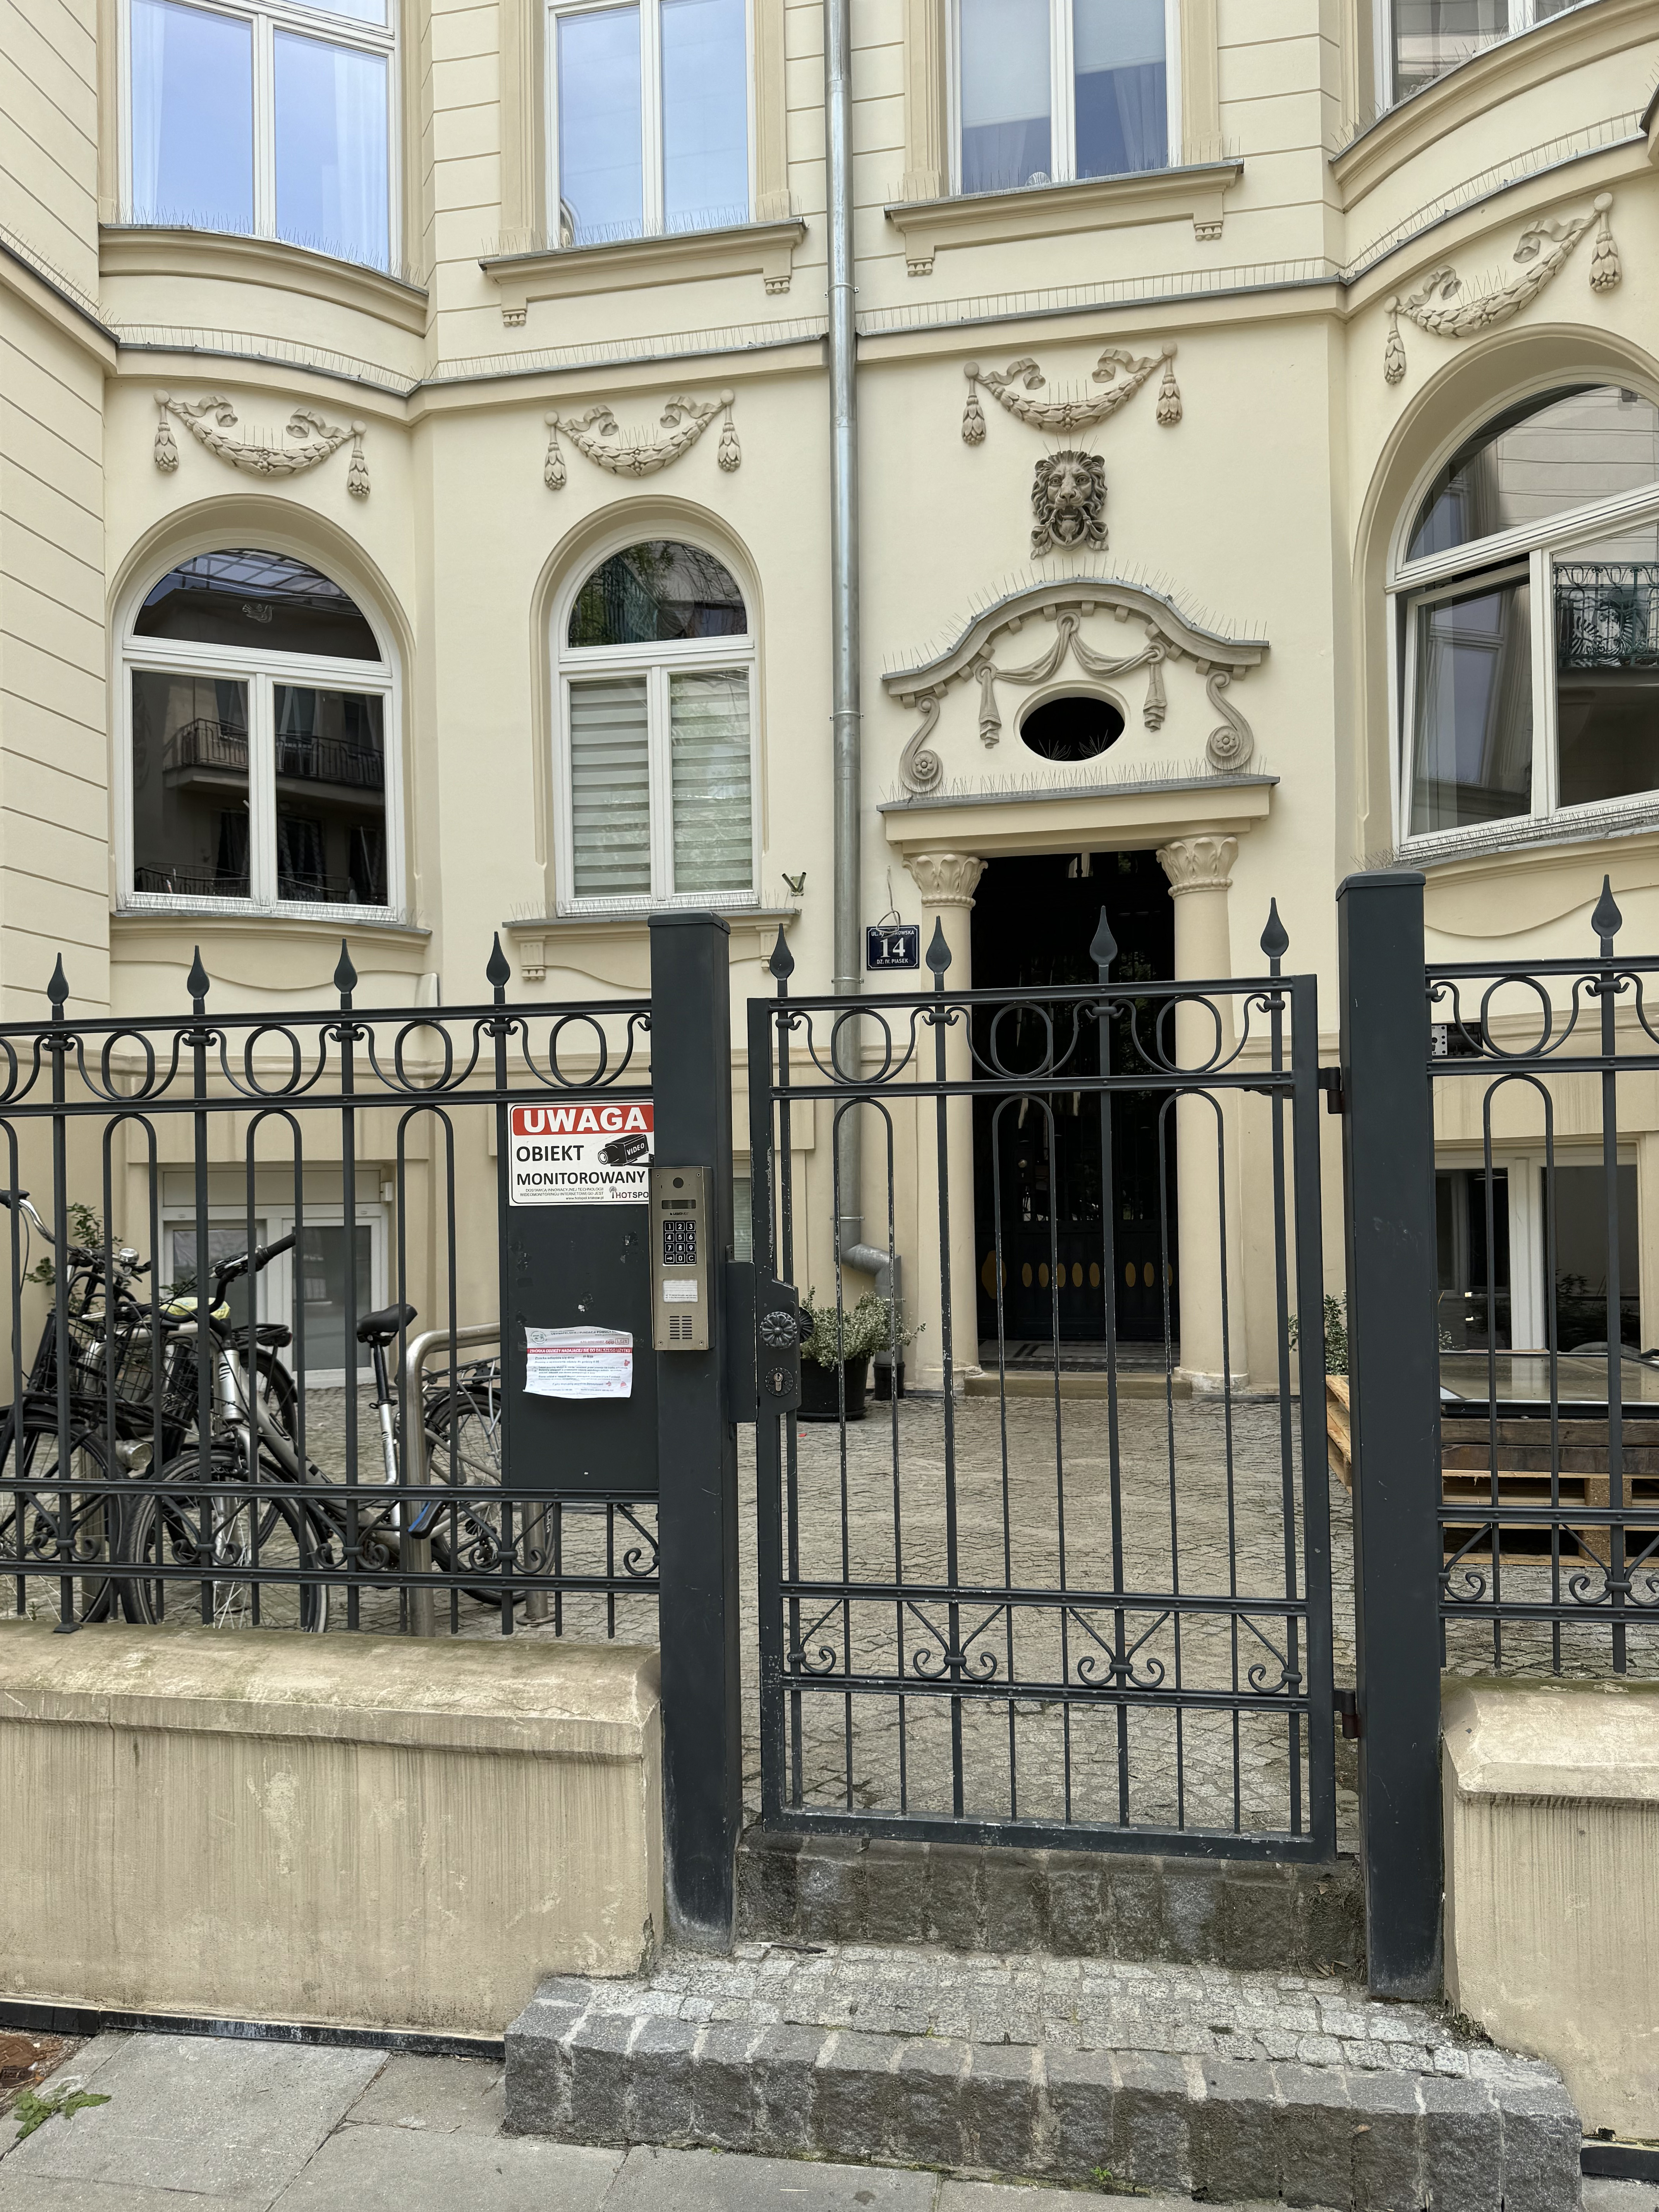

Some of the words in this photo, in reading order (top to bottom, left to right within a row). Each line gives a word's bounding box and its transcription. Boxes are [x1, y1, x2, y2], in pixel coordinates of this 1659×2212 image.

[880, 937, 905, 958] 14
[524, 1107, 647, 1133] UWAGA
[517, 1145, 584, 1162] OBIEKT
[627, 1143, 644, 1156] VIDEO
[517, 1171, 646, 1185] MONITOROWANY
